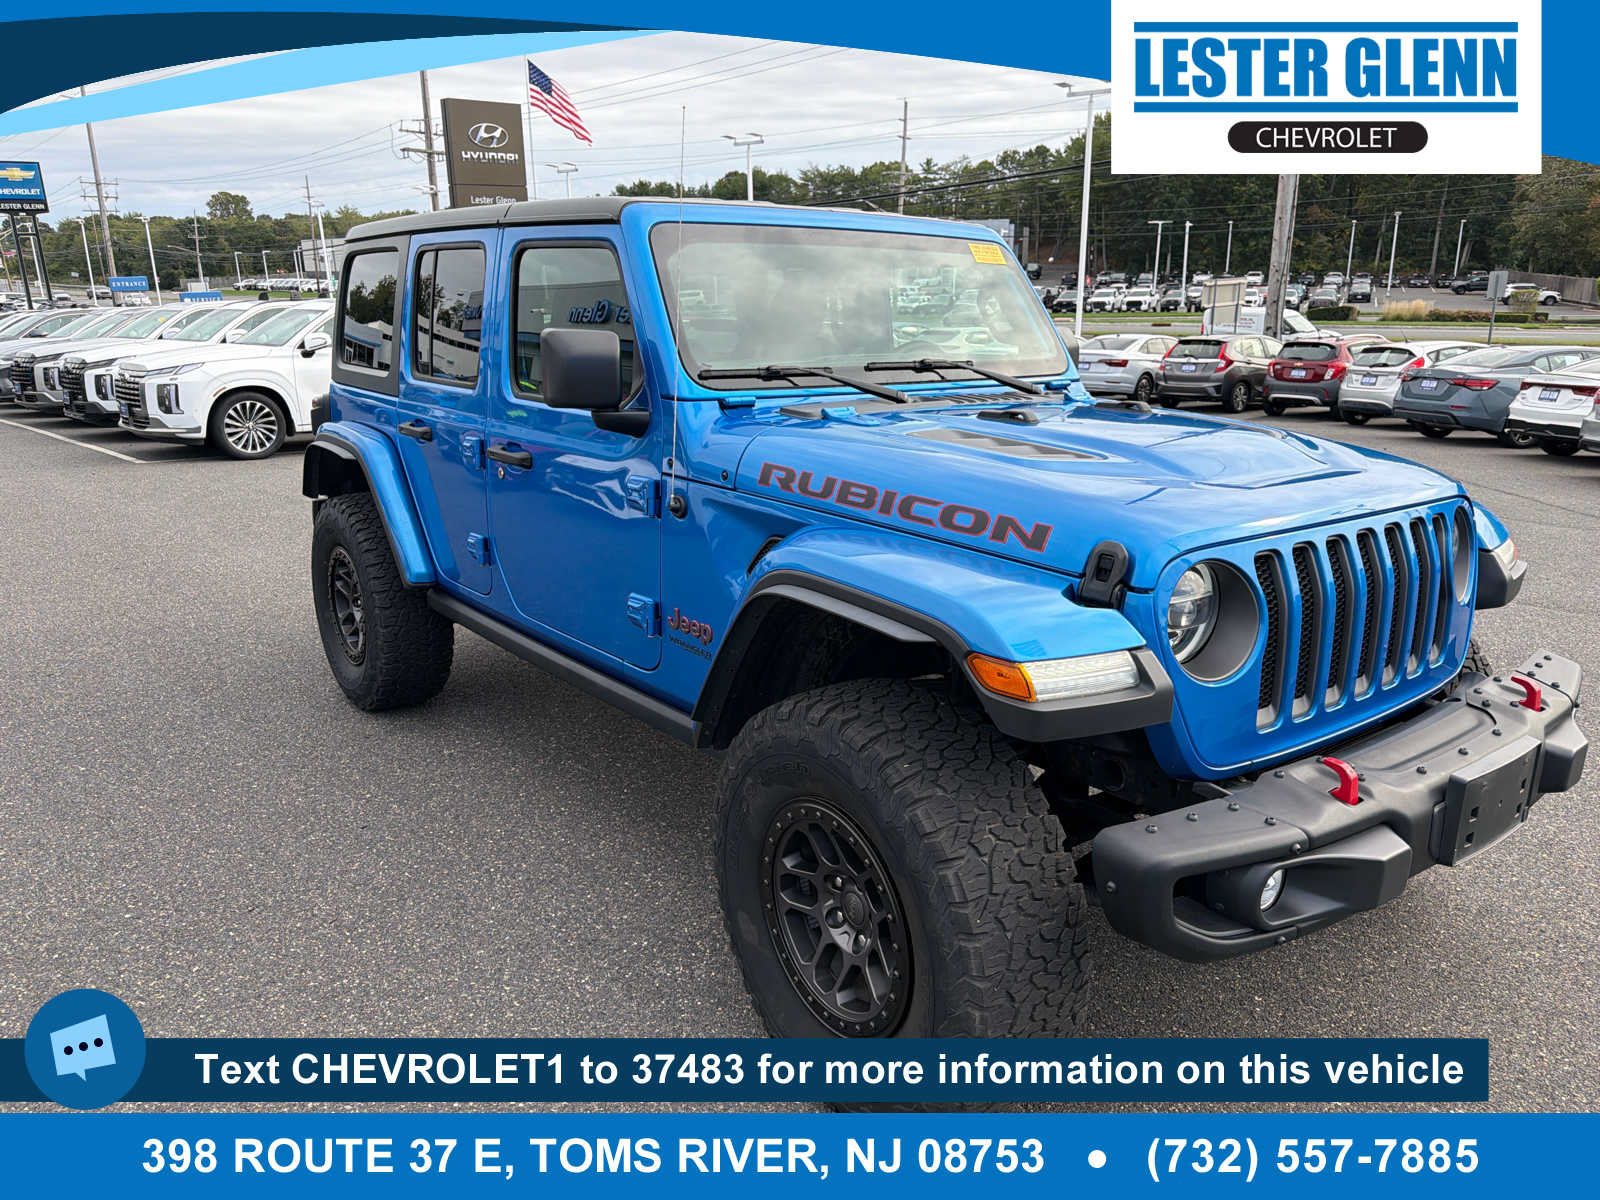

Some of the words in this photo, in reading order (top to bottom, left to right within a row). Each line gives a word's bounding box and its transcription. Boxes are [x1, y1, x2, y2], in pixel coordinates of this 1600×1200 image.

[461, 150, 519, 163] HYUNDAI
[0, 188, 40, 196] HEVROLET
[470, 195, 494, 205] Lester
[757, 462, 1054, 553] RUBICON
[667, 607, 713, 646] Jeep
